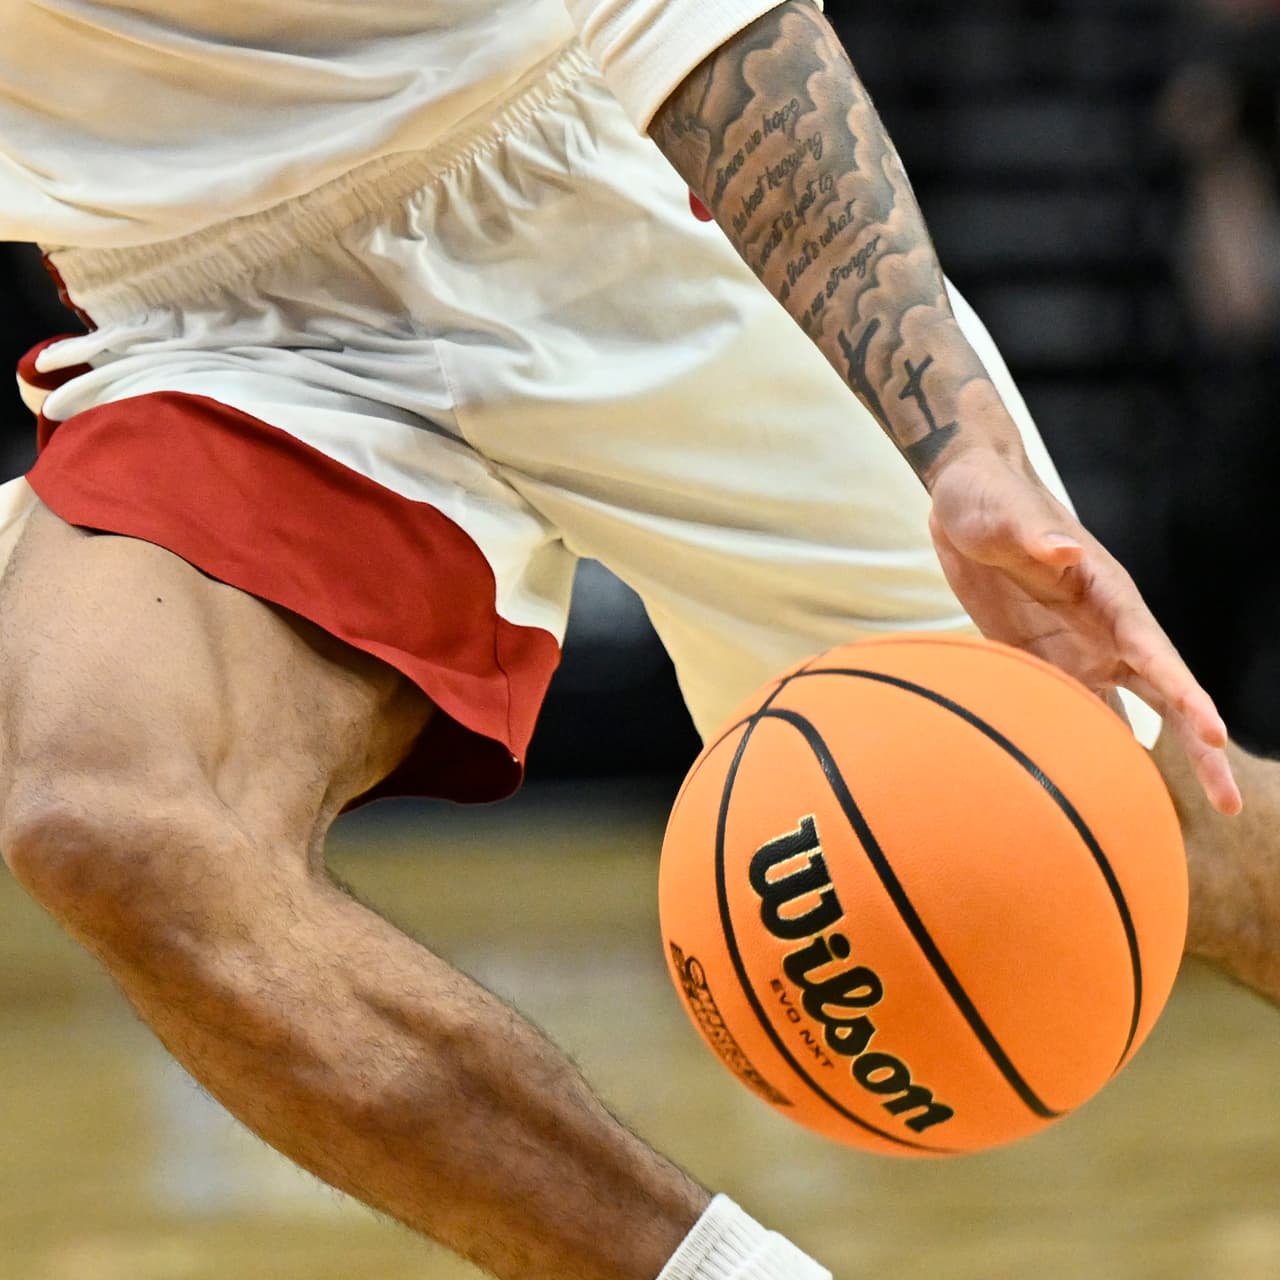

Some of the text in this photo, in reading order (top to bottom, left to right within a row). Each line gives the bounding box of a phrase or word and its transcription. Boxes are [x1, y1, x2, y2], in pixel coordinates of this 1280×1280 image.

[820, 198, 857, 247] what
[826, 235, 881, 299] stronger
[748, 814, 954, 1134] Wilson
[770, 979, 835, 1070] EVO NXT
